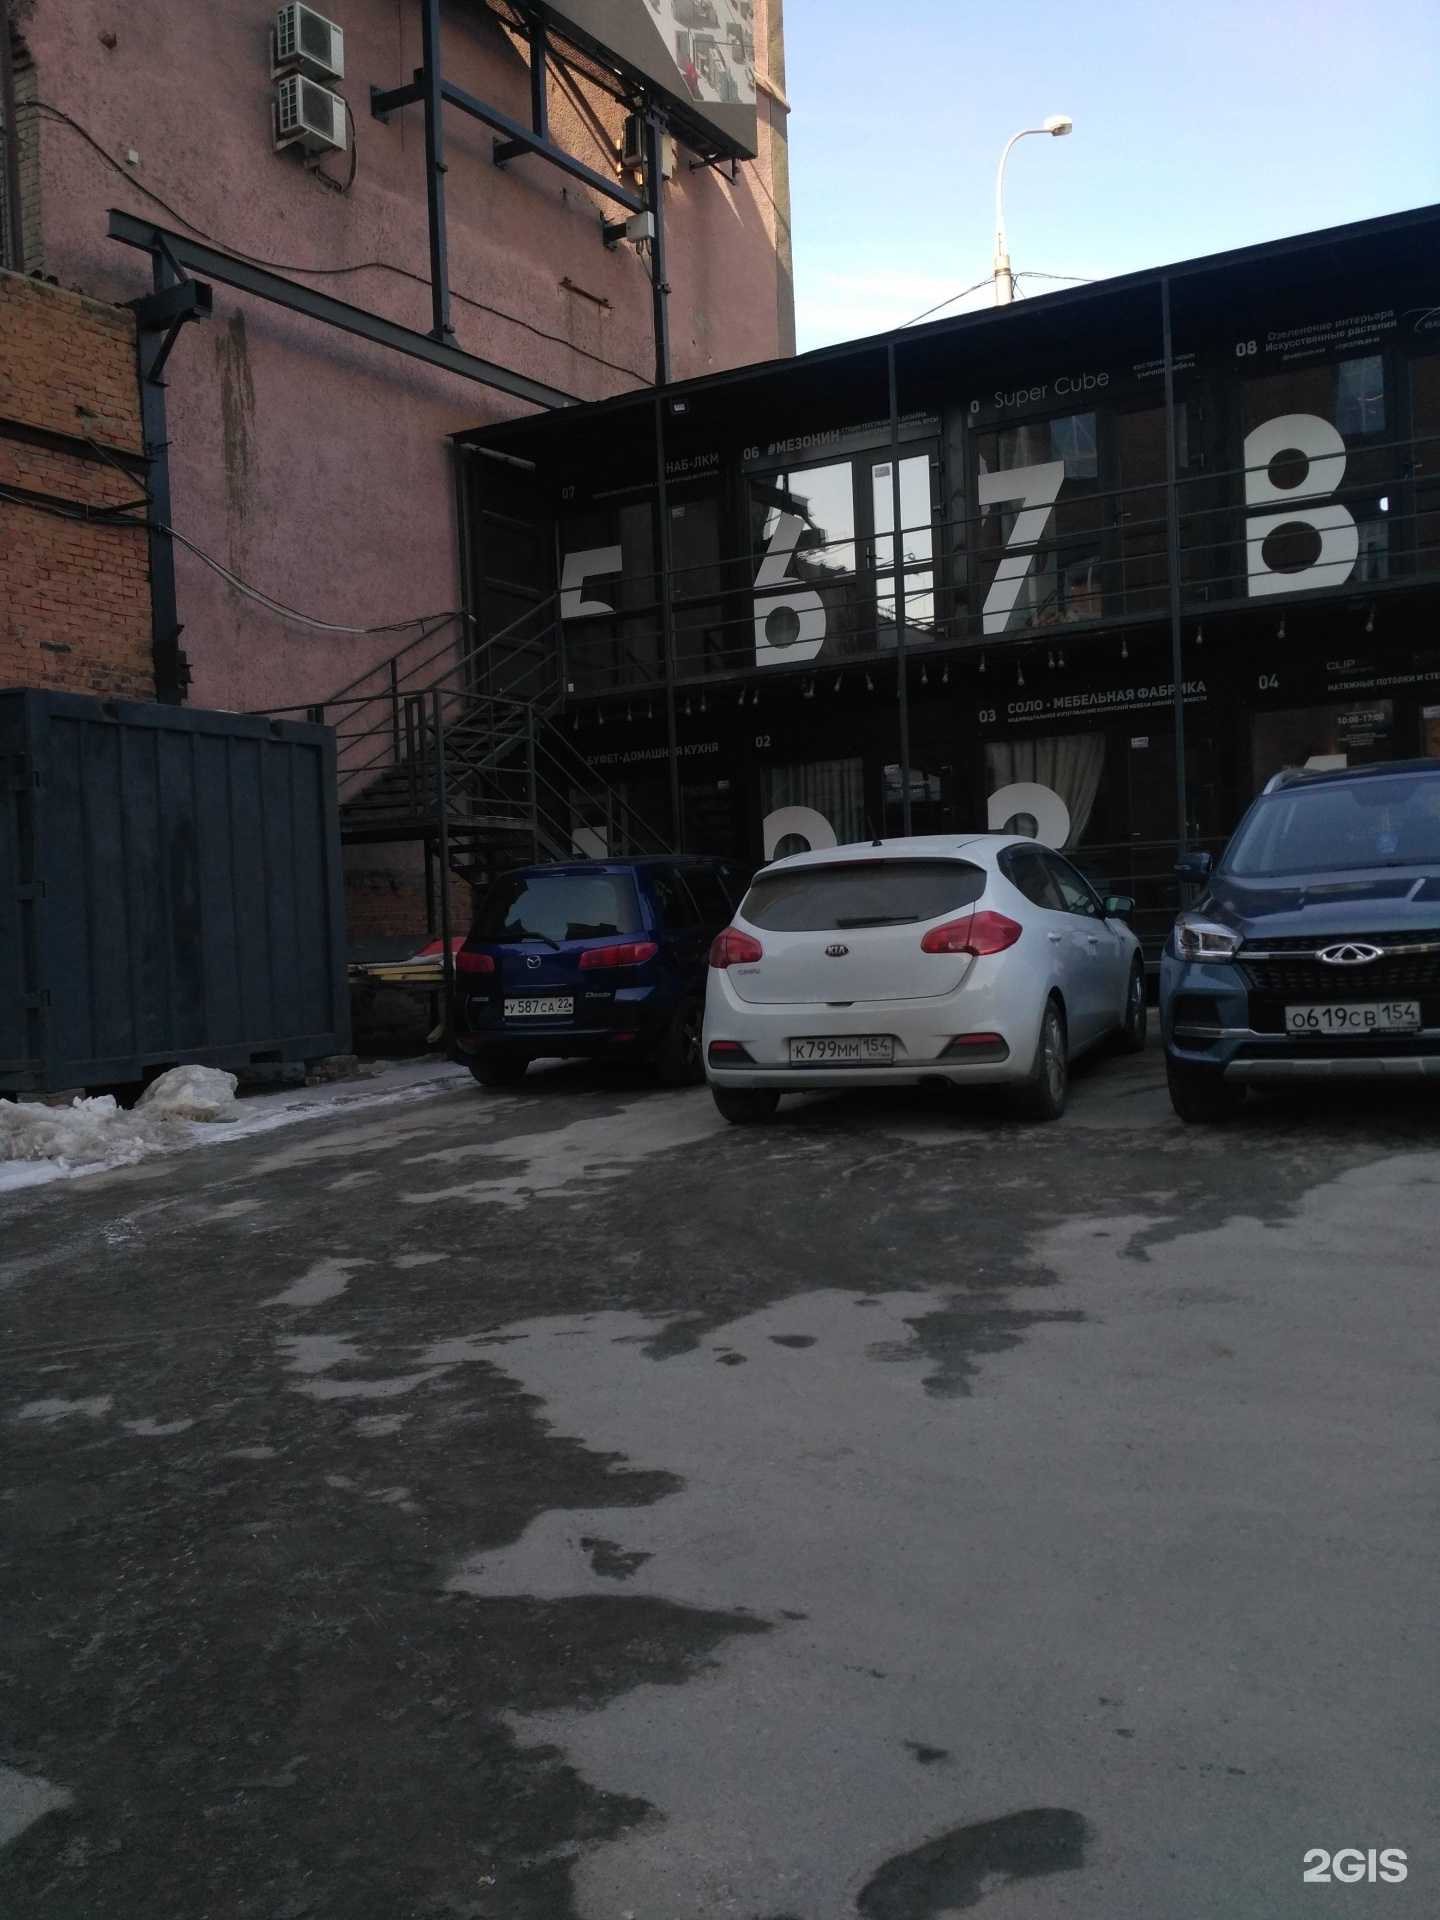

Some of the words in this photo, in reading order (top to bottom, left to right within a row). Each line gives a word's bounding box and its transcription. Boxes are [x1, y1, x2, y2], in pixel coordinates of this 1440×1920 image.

[1235, 340, 1258, 358] 08
[993, 385, 1047, 409] Super
[1054, 371, 1110, 396] Cube
[767, 428, 841, 456] #МЕЗОНИН
[743, 447, 760, 460] 06
[1243, 413, 1359, 598] 8
[978, 460, 1065, 635] 7
[753, 511, 827, 668] 6
[1258, 673, 1279, 690] 04
[1007, 699, 1043, 714] СОЛО
[1053, 690, 1135, 709] МЕБЕЛЬНАЯ
[979, 709, 997, 723] 03
[755, 735, 771, 748] 02
[558, 998, 569, 1009] 22
[1292, 1007, 1376, 1028] О619СВ
[1382, 1003, 1415, 1020] 154
[796, 1040, 859, 1058] К799ММ
[863, 1038, 888, 1051] 154
